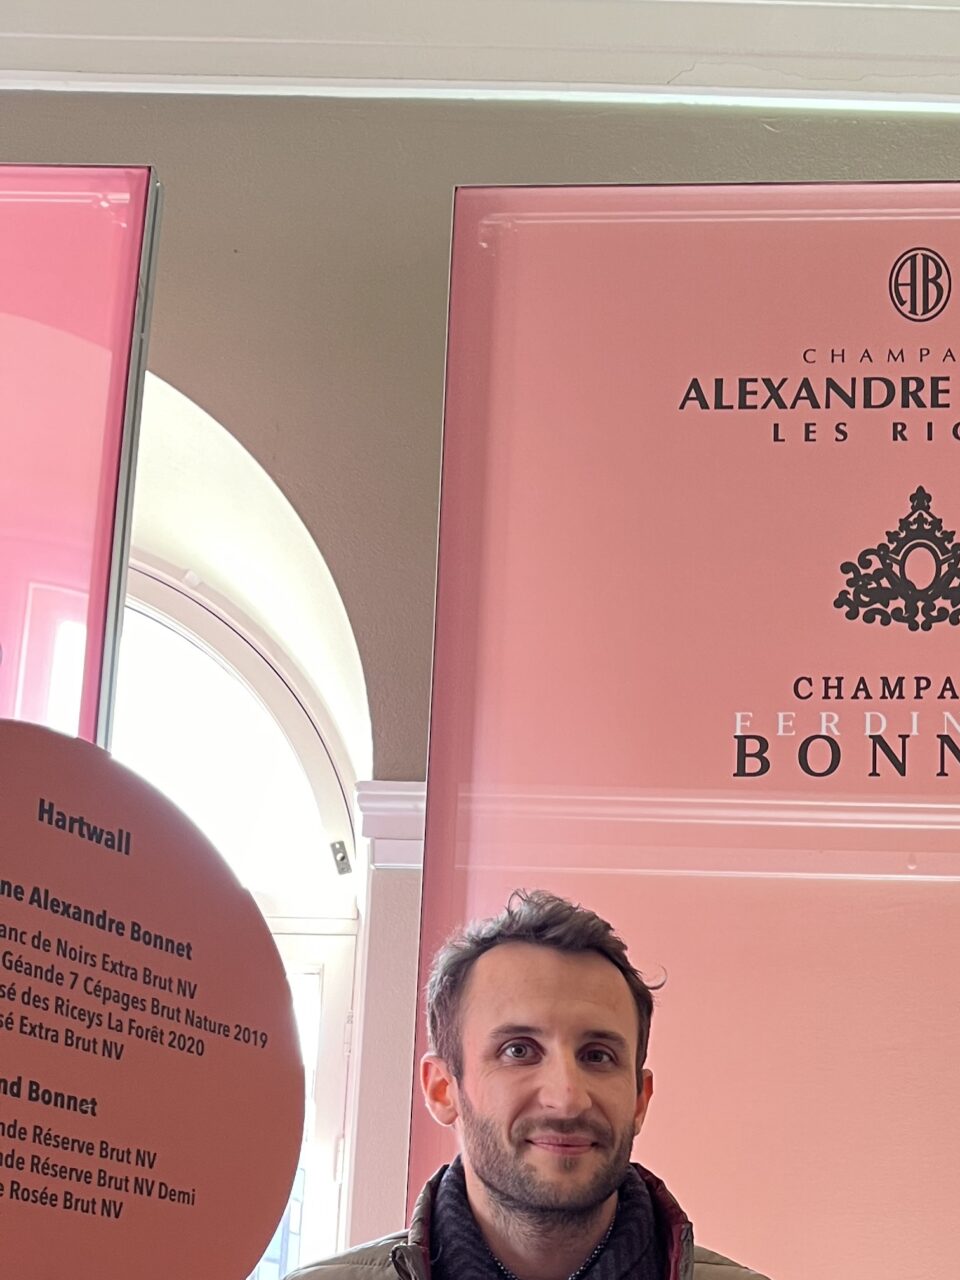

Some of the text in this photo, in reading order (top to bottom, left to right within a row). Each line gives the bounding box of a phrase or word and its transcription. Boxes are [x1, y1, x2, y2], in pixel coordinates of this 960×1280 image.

[679, 376, 952, 410] ALEXANDRE
[772, 422, 849, 442] LES
[38, 798, 131, 855] Hartwall
[0, 879, 193, 960] ne Alexandre Bonnet
[0, 923, 197, 1000] anc de Noirs Extra Brut NV
[0, 982, 205, 1057] sé des Riceys La Forêt 2020
[2, 951, 268, 1049] Géande 7 Cépages Brut Nature 2019
[20, 1016, 59, 1043] Extra
[64, 1028, 97, 1055] Brut
[102, 1039, 124, 1060] NV
[0, 1076, 97, 1117] nd Bonnet
[0, 1119, 157, 1169] nde Réserve Brut NV
[9, 1180, 58, 1207] Rosée
[63, 1191, 97, 1215] Brut
[100, 1198, 123, 1219] NV
[30, 1154, 93, 1185] Réserve
[97, 1168, 130, 1193] Brut
[133, 1176, 155, 1197] NV
[158, 1182, 196, 1206] Demi
